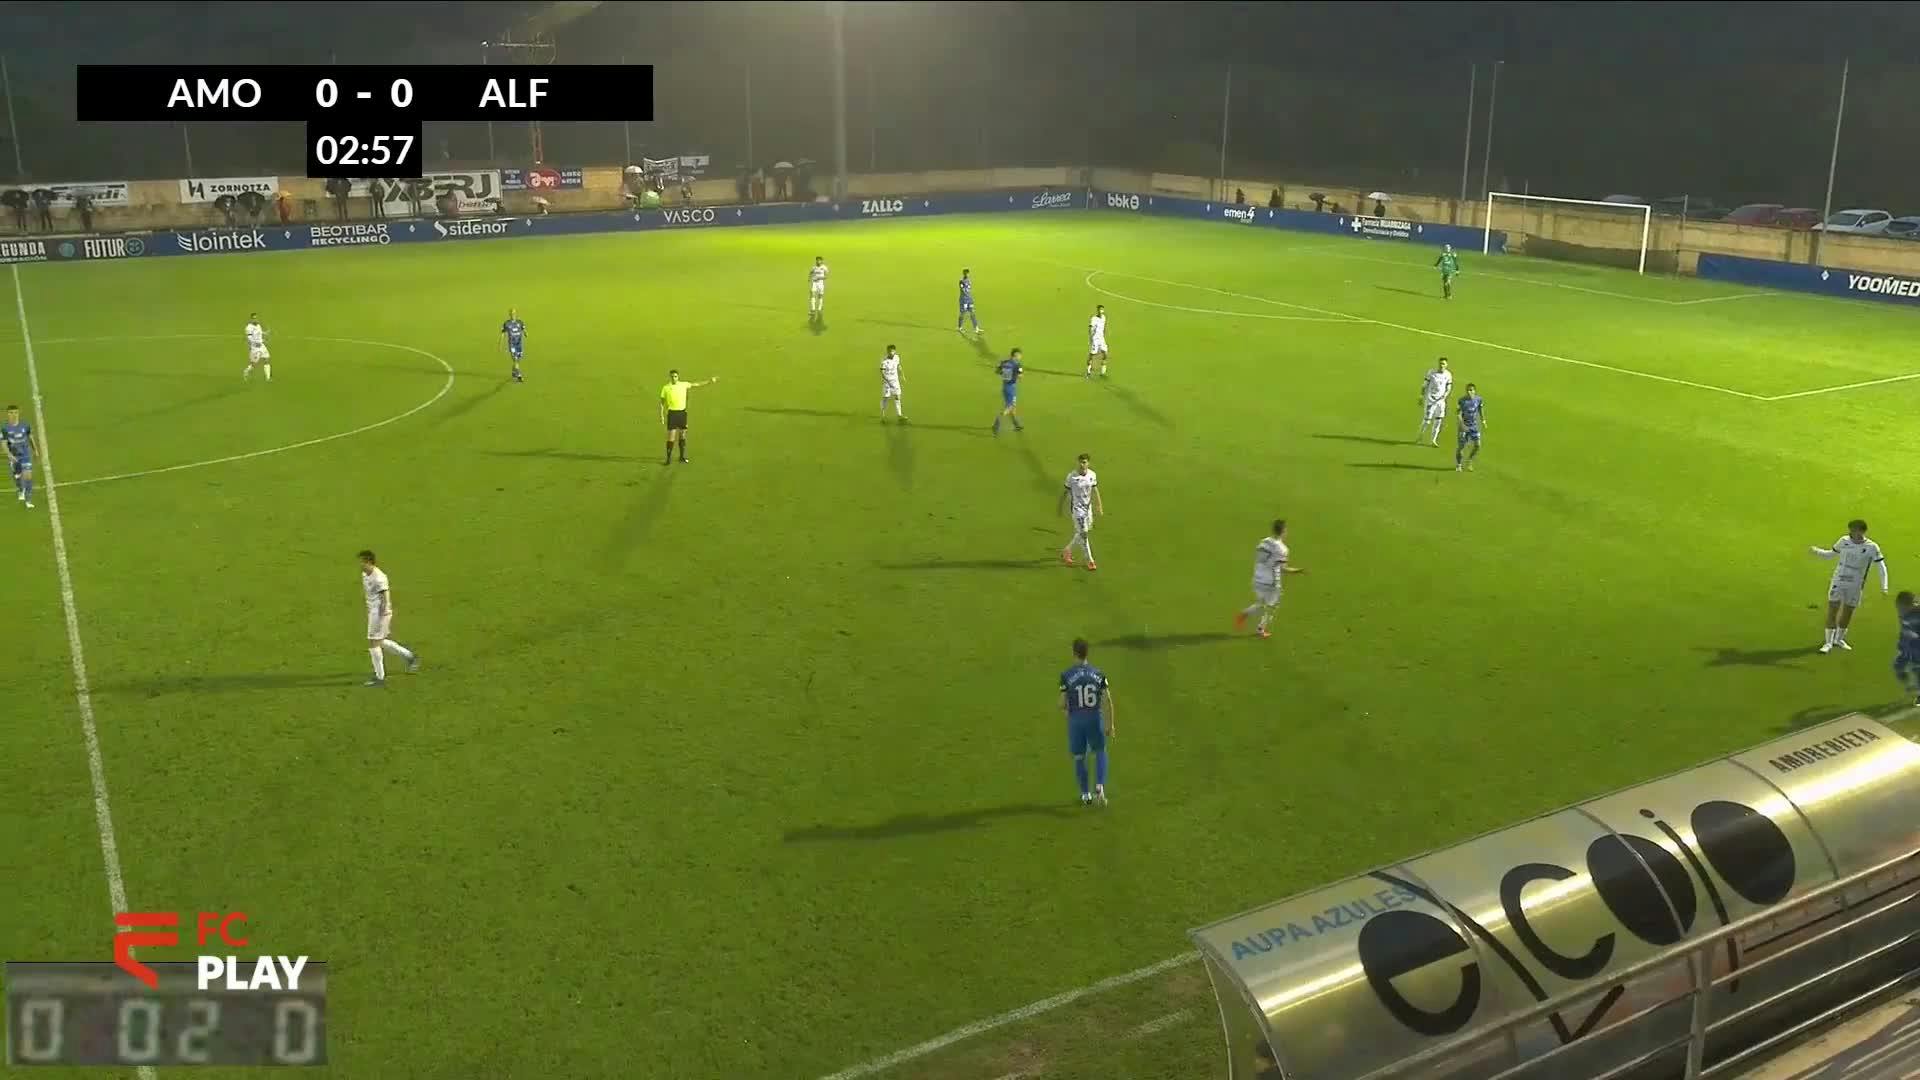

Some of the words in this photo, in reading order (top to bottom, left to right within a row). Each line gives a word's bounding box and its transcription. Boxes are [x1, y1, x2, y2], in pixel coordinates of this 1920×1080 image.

[209, 183, 271, 193] ZORNOTZA
[862, 200, 903, 213] ZALLO
[663, 209, 715, 223] VASCO
[310, 223, 388, 238] BEOTIBAR
[450, 222, 508, 236] sidenor
[192, 230, 266, 251] lointek
[0, 242, 46, 257] GUNDA
[1075, 683, 1098, 708] 16
[1769, 728, 1881, 773] AMOREBIETA
[1231, 921, 1313, 961] AUPA
[1311, 883, 1418, 934] AZULES
